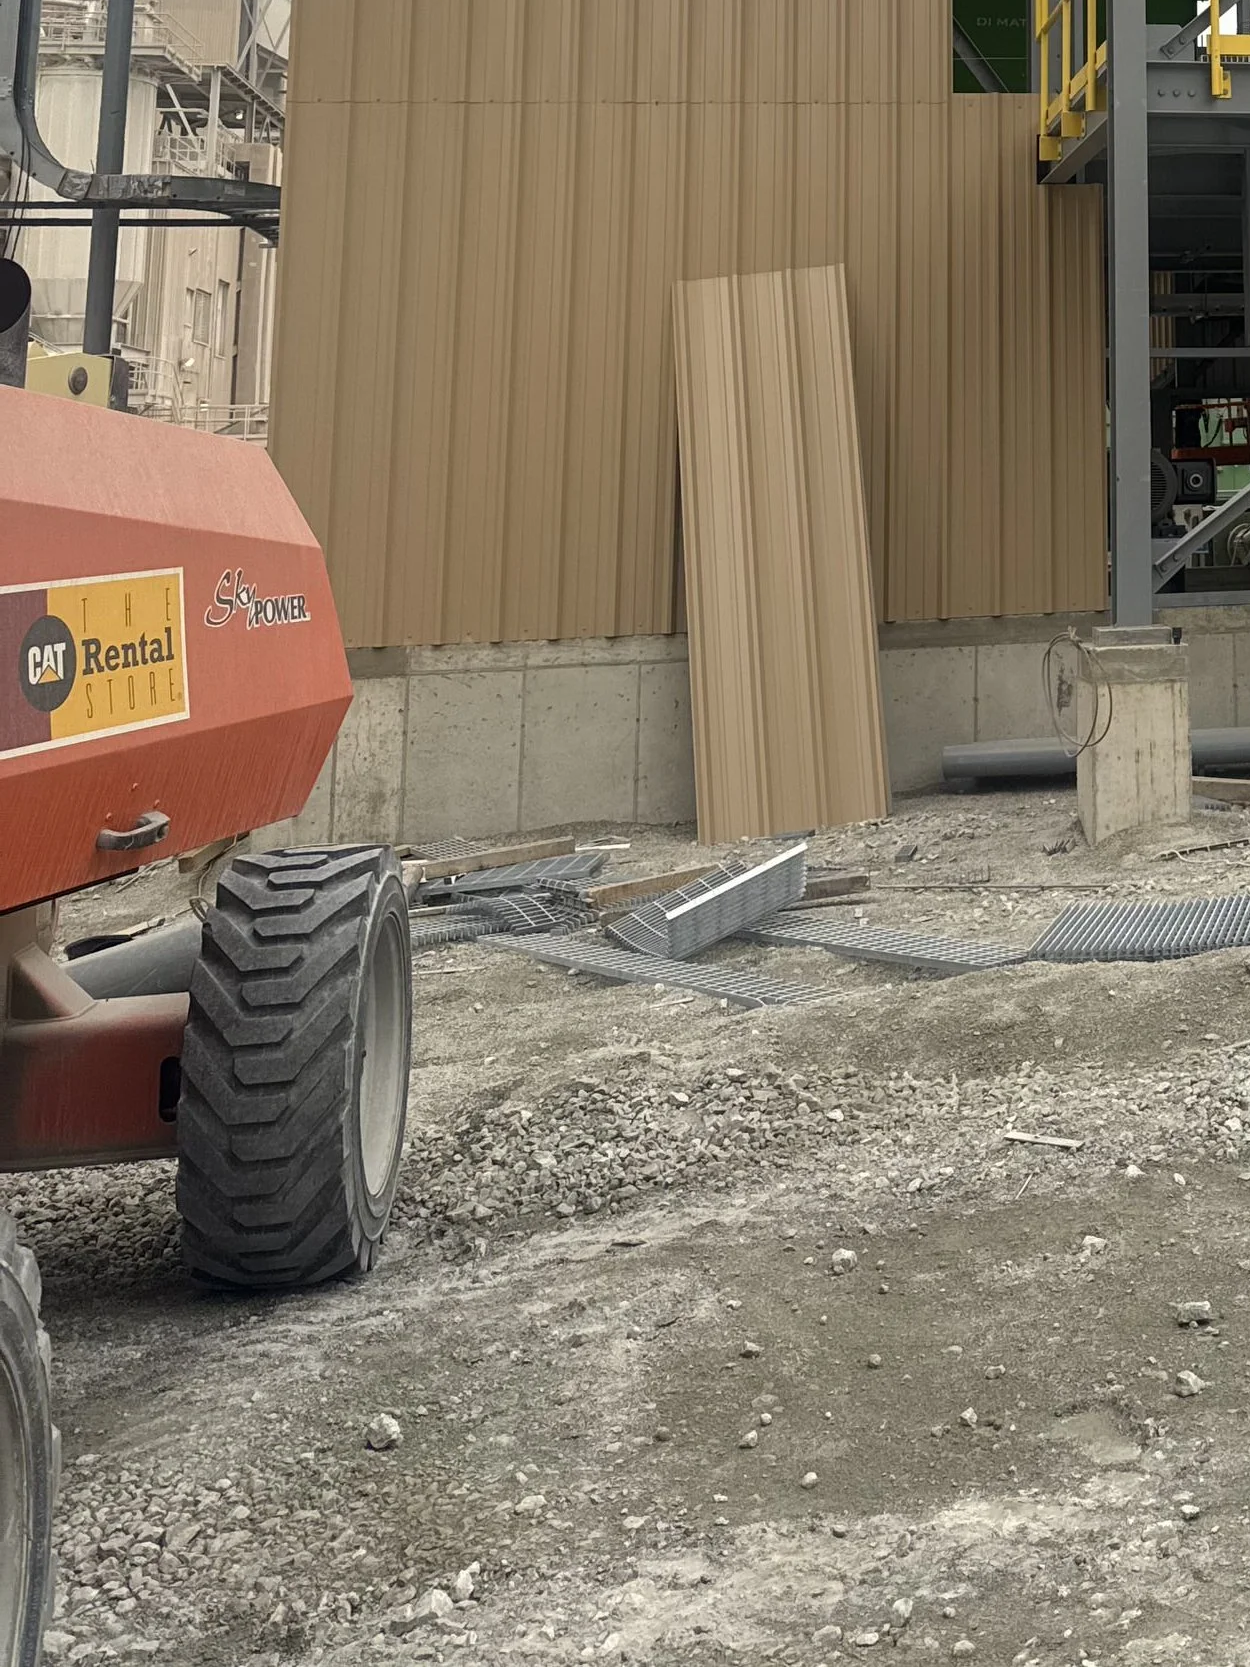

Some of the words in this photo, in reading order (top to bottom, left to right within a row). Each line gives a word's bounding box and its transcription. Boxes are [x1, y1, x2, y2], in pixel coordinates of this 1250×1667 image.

[81, 587, 171, 633] THE
[27, 642, 66, 686] CAT
[81, 626, 175, 676] Rental
[85, 668, 176, 719] STORE
